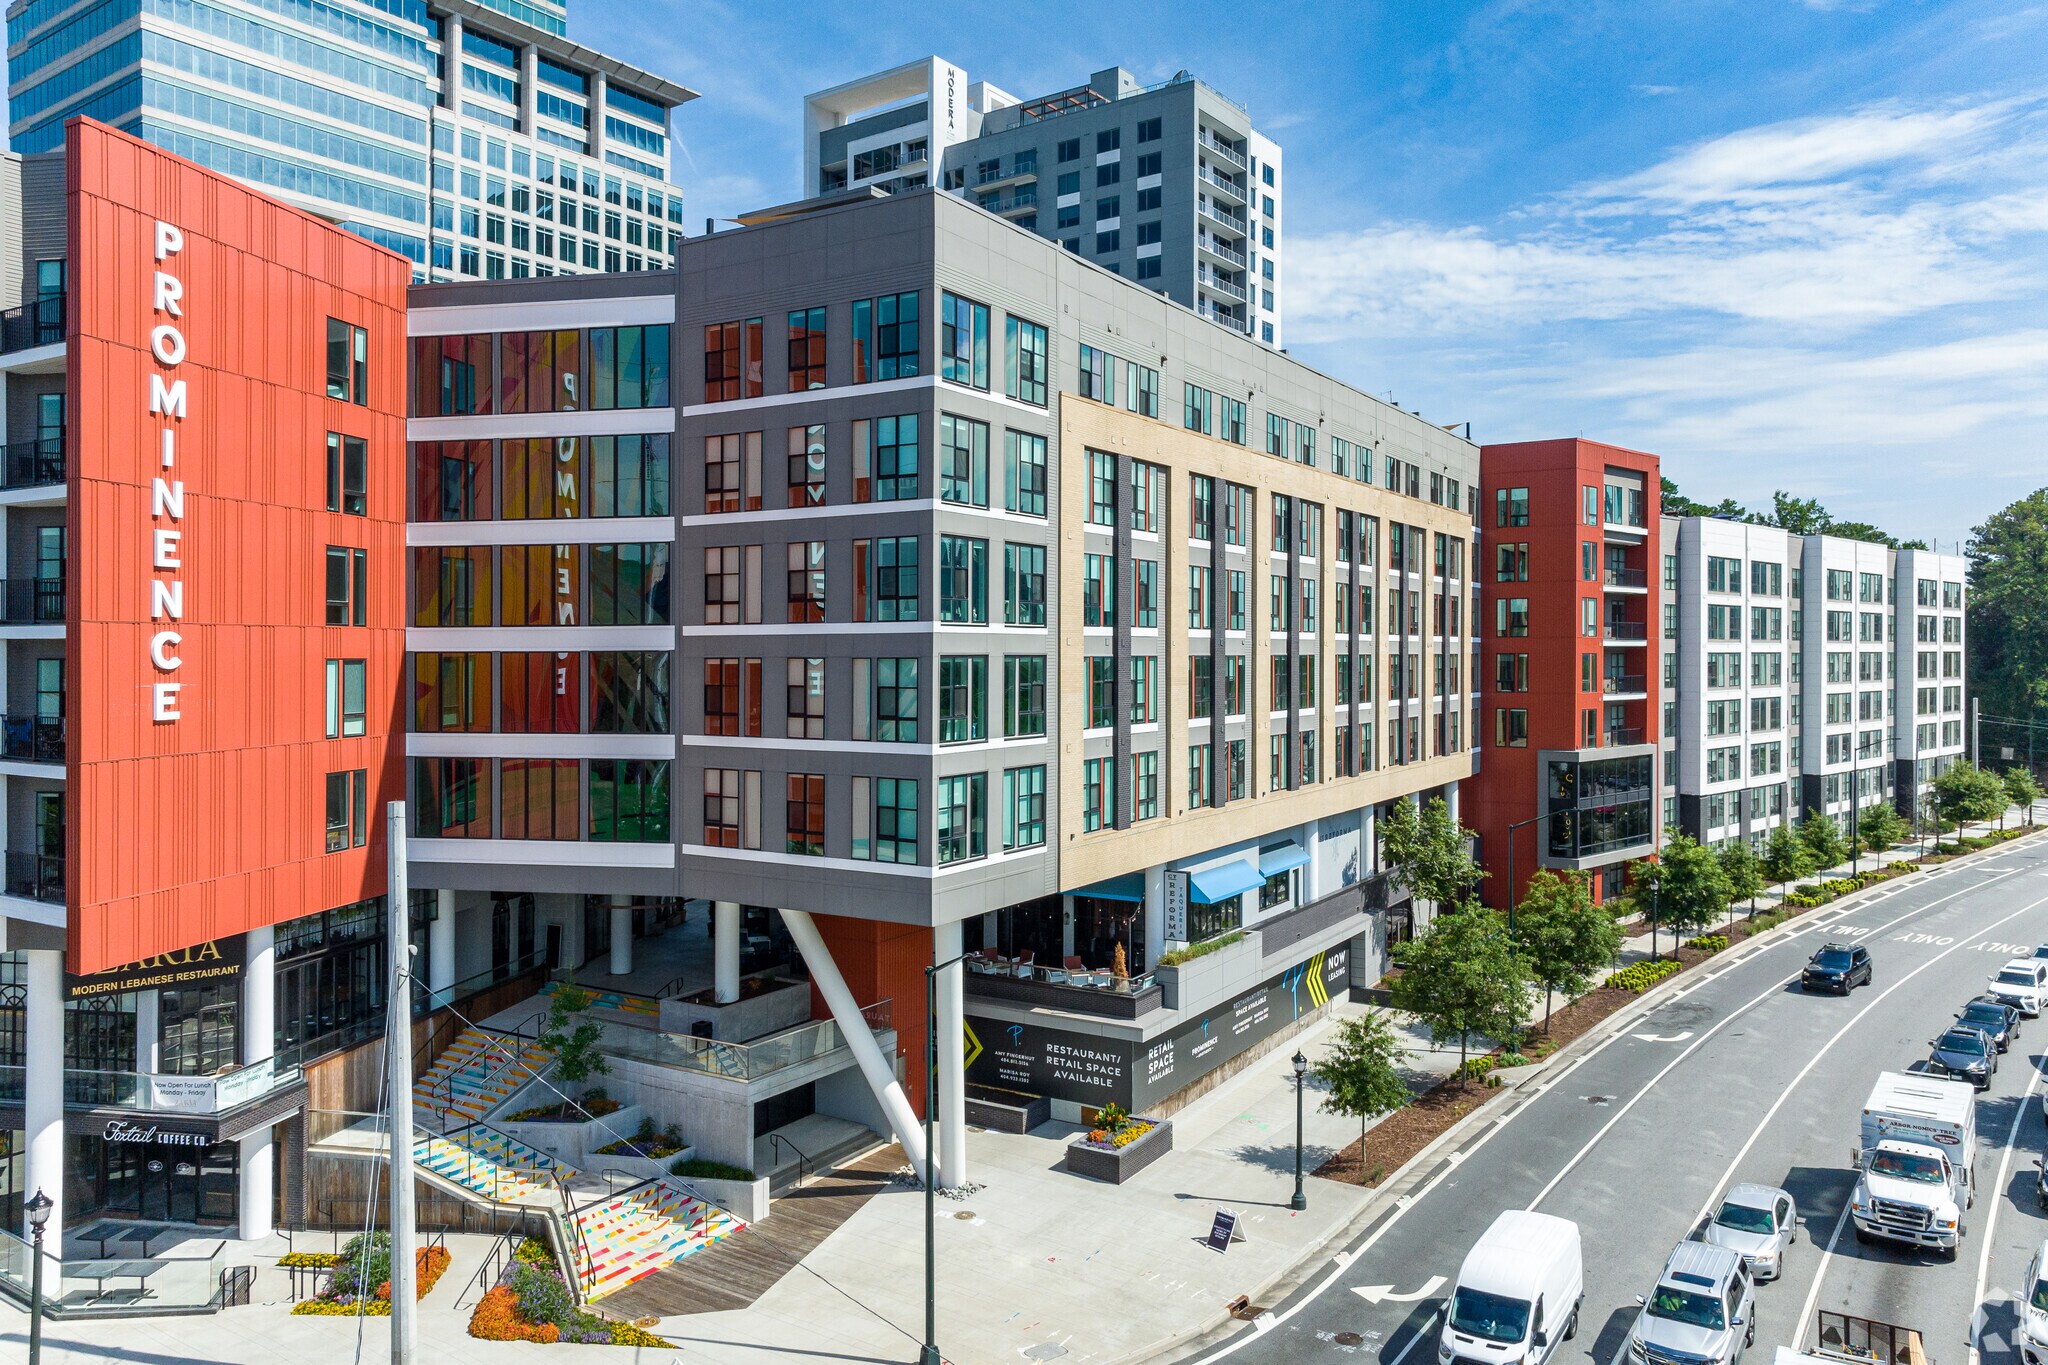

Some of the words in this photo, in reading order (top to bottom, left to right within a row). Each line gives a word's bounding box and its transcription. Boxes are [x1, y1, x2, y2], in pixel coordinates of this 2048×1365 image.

[947, 67, 955, 130] MODERA
[149, 220, 187, 723] PROMINENCE
[1168, 881, 1176, 938] REFORMA
[1817, 924, 1870, 936] ONLY
[1893, 932, 1955, 946] ONLY
[1966, 941, 2031, 955] ONLY
[1328, 950, 1346, 971] NOW
[72, 981, 118, 996] MODERN
[120, 974, 174, 989] LEBANESE
[176, 965, 240, 981] RESTAURANT
[1328, 966, 1345, 982] LEASING
[1046, 1043, 1122, 1064] RESTAURANT/
[1148, 1038, 1175, 1061] RETAIL
[1191, 1036, 1219, 1056] PROMINENCE
[1046, 1055, 1083, 1070] RETAIL
[1086, 1063, 1122, 1077] SPACE
[1148, 1052, 1174, 1074] SPACE
[1053, 1070, 1113, 1088] AVAILABLE
[1147, 1065, 1174, 1085] AVAILABLE
[103, 1120, 157, 1143] Foxtail
[157, 1134, 190, 1145] COFFEE
[193, 1136, 209, 1146] CO.
